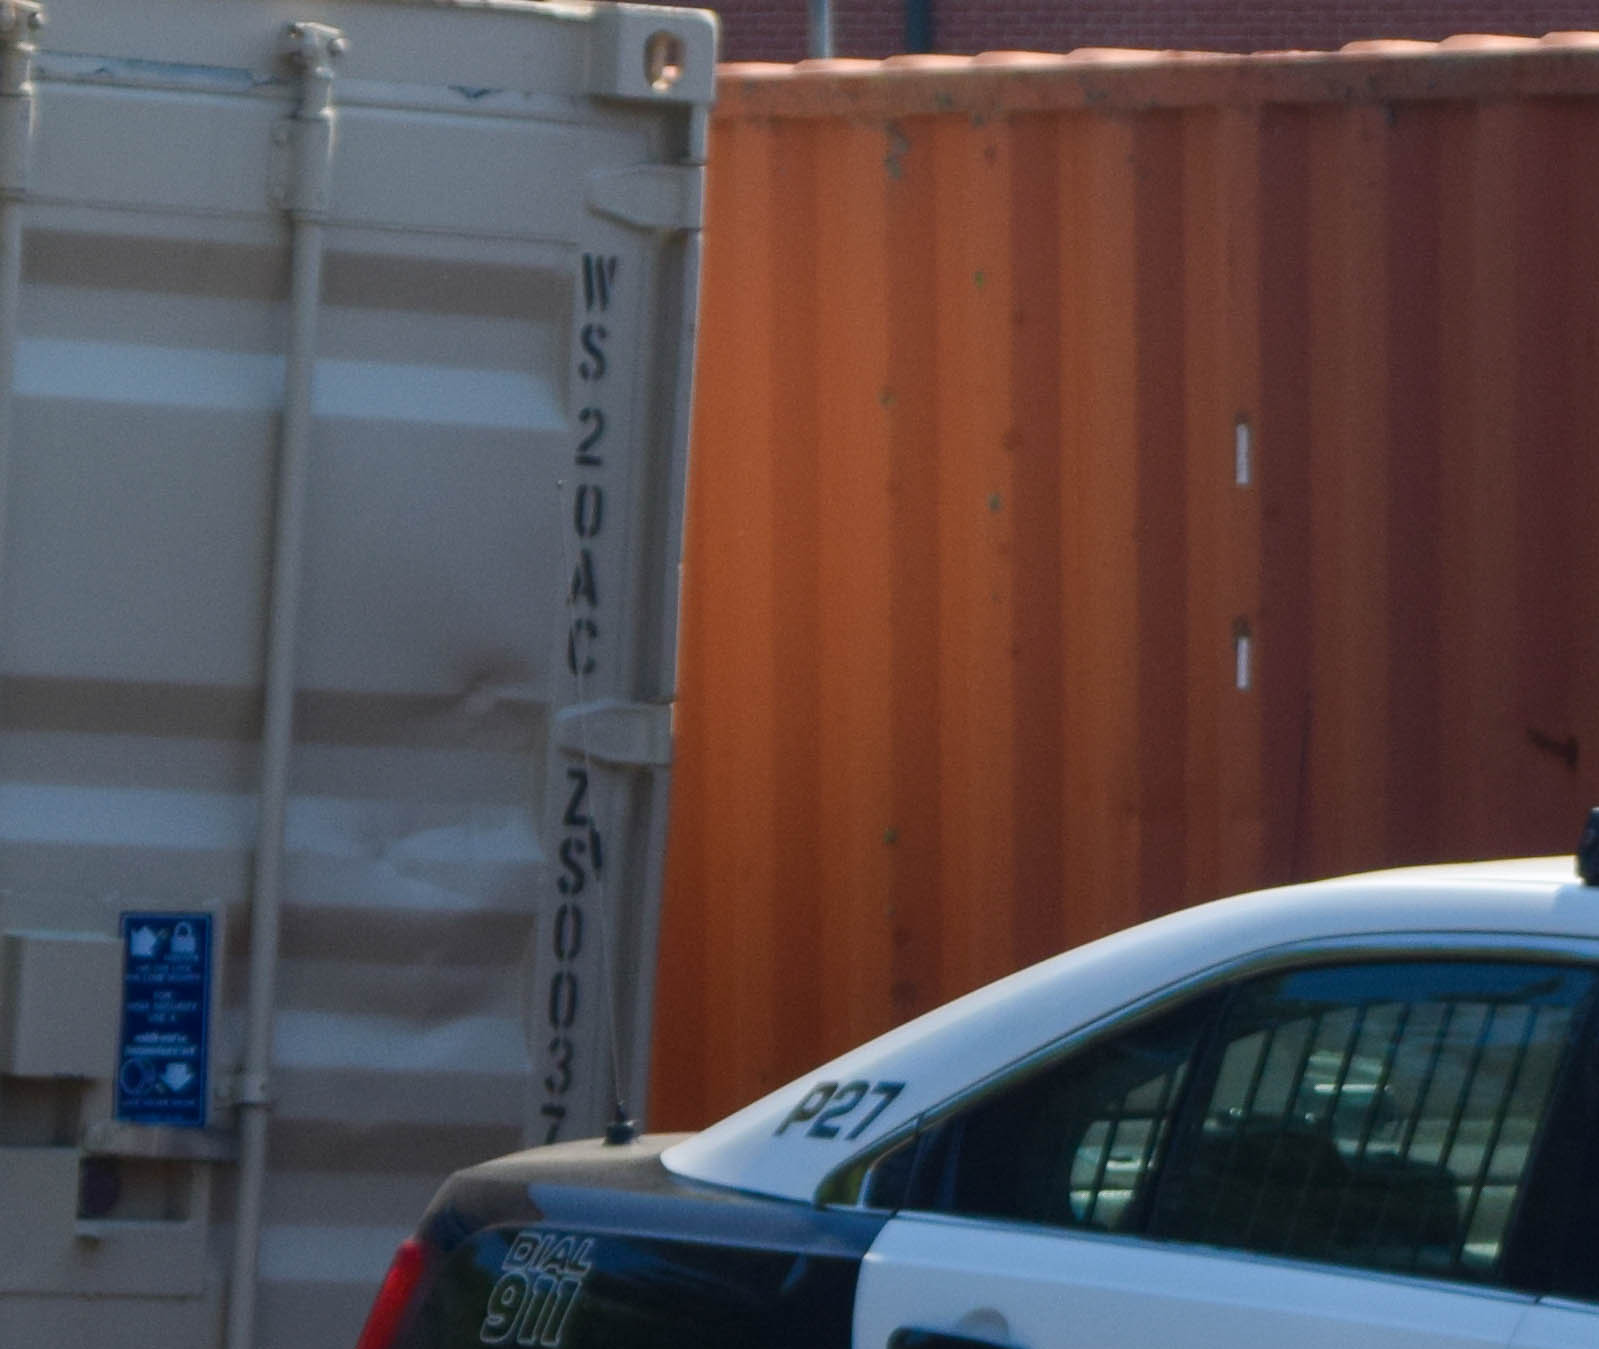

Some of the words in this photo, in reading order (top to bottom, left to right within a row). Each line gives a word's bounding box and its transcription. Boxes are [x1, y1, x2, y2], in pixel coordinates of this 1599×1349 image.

[774, 1081, 906, 1140] P27
[502, 1232, 596, 1279] DIAL
[480, 1271, 583, 1349] 911
